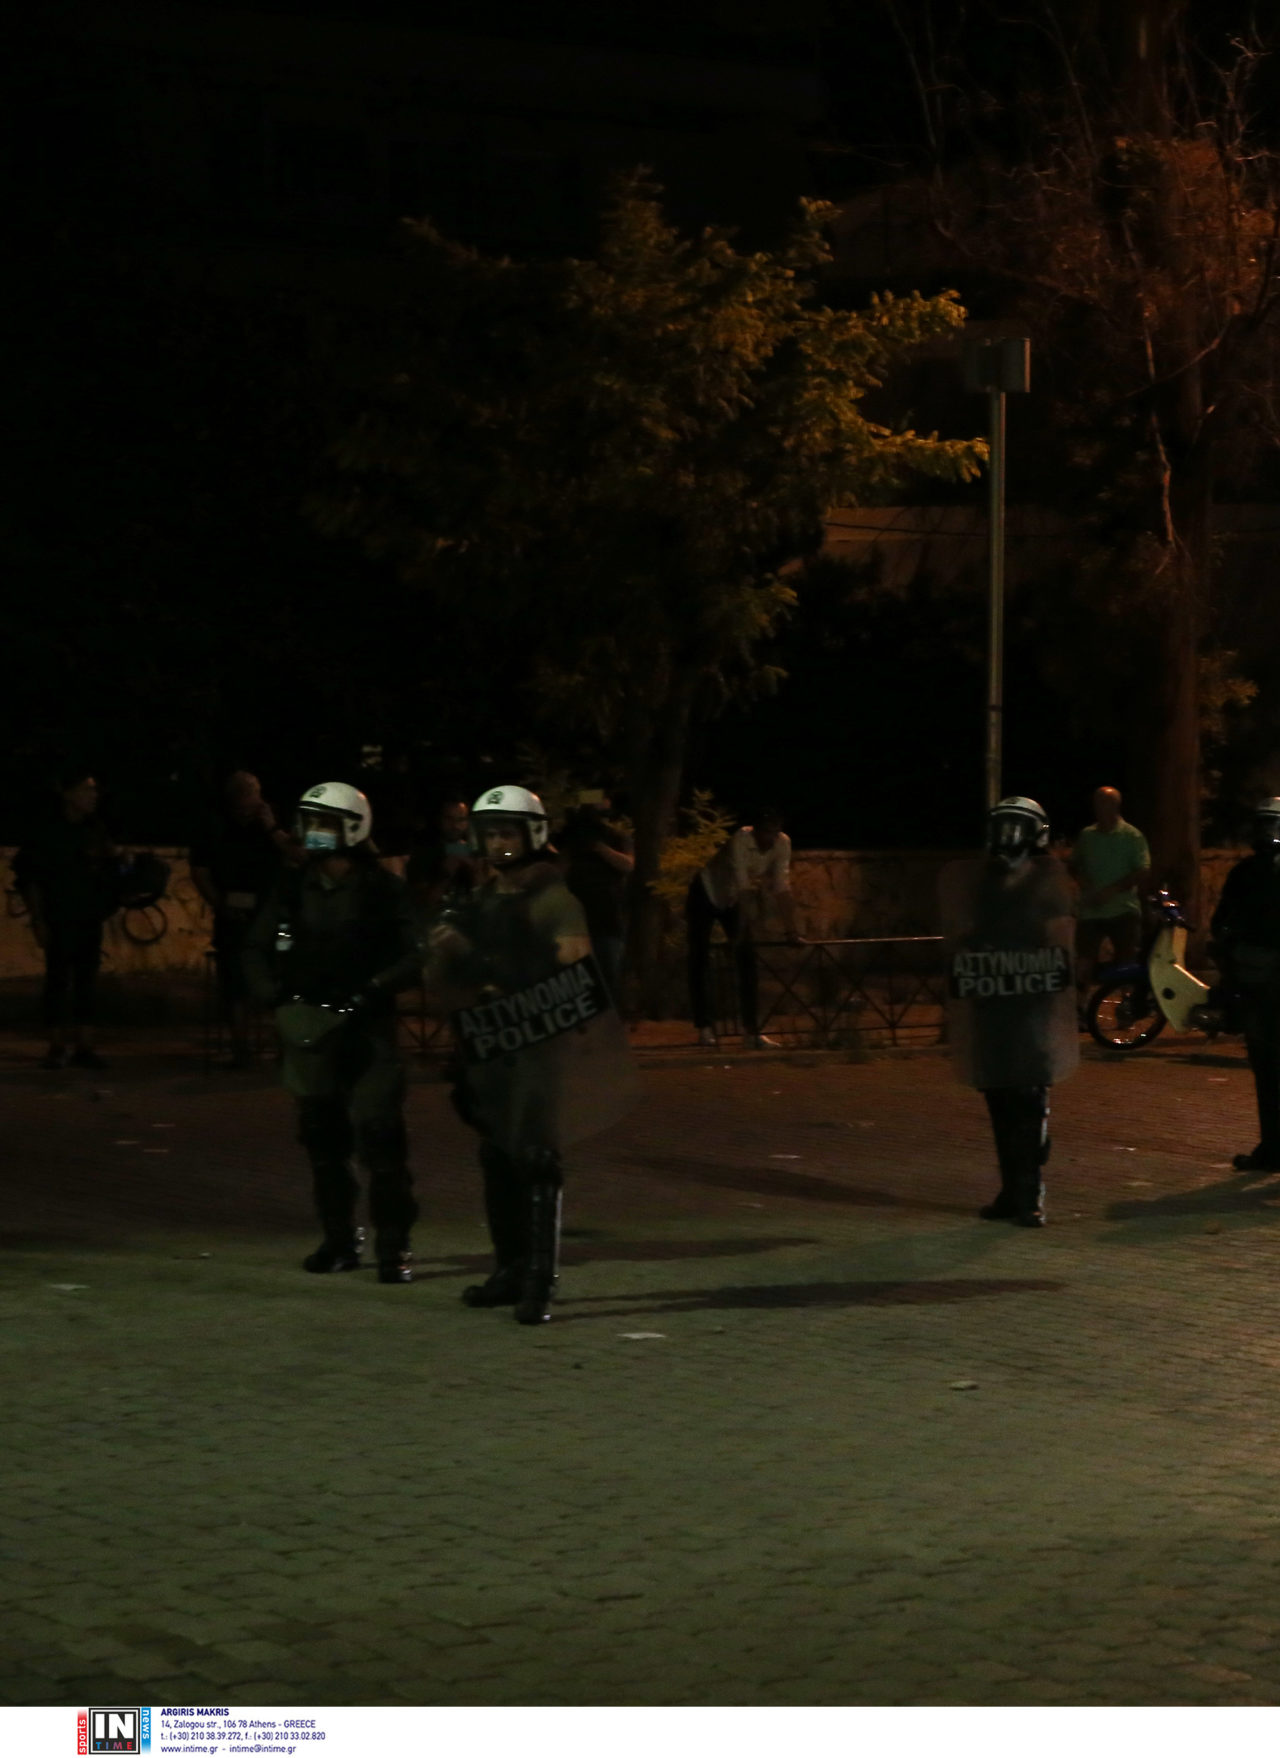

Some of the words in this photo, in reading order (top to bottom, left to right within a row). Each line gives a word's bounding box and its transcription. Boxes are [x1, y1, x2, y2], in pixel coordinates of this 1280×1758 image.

[459, 961, 596, 1040] ΑΣΤΥΝΟΜΙΑ
[957, 971, 1062, 998] POLICE
[472, 990, 598, 1060] POLICE
